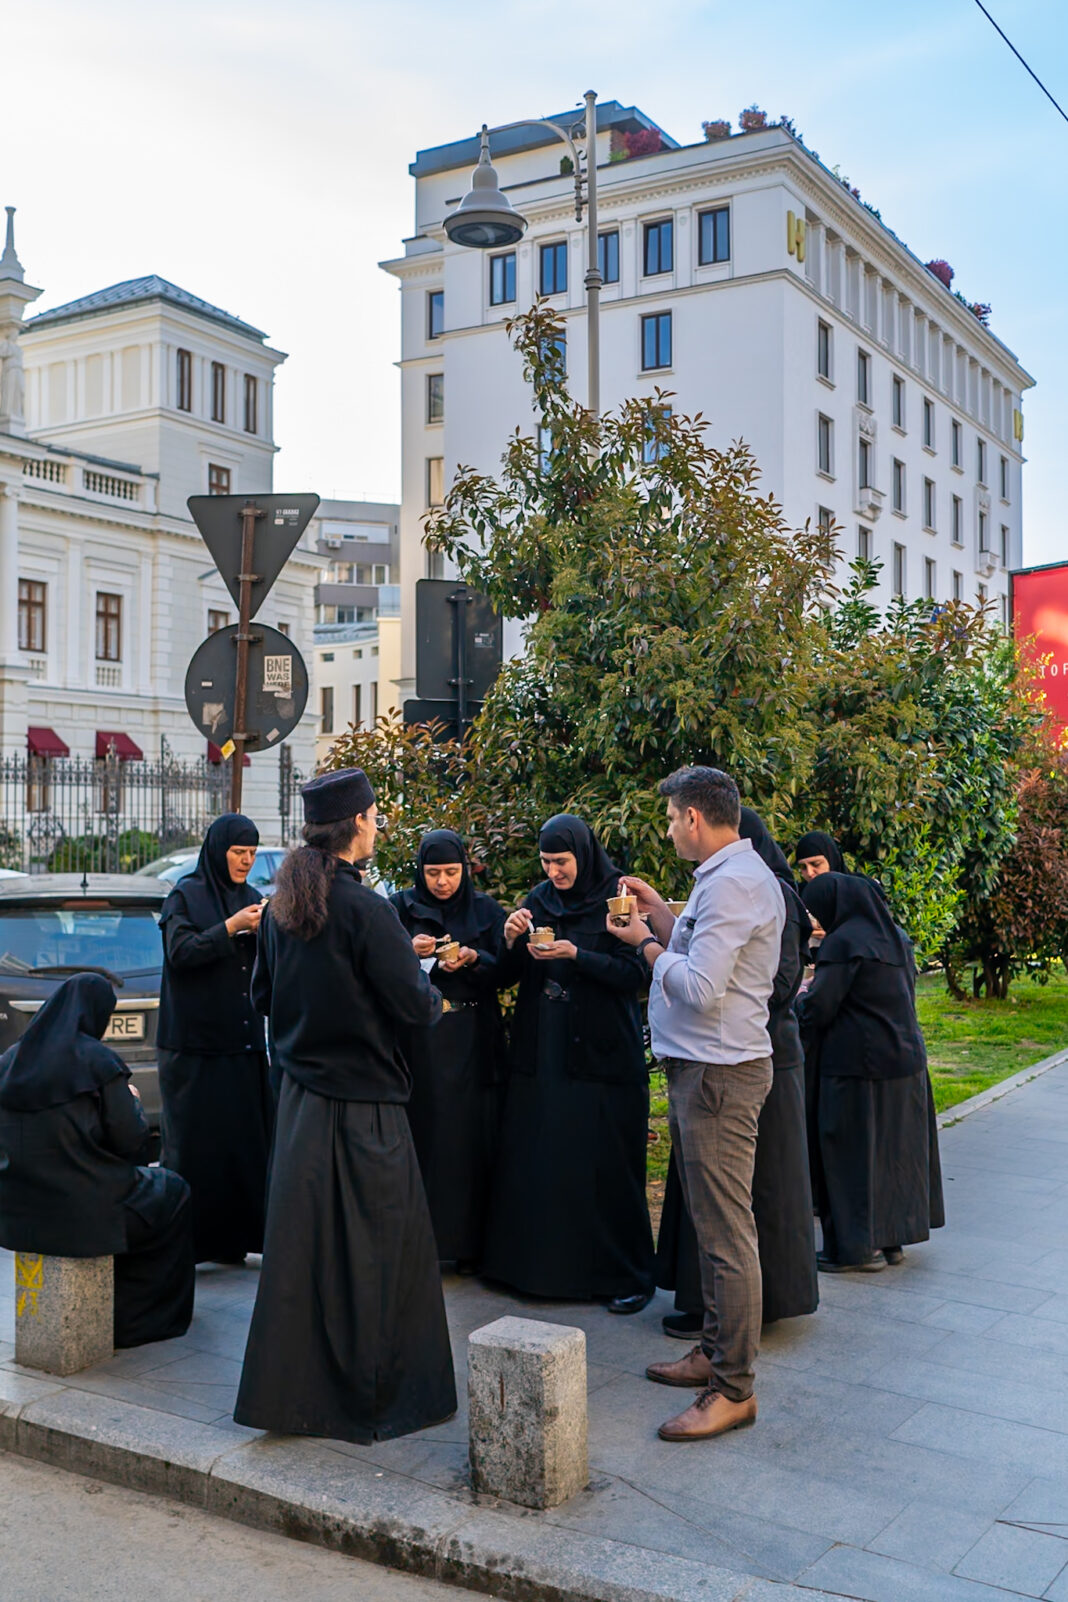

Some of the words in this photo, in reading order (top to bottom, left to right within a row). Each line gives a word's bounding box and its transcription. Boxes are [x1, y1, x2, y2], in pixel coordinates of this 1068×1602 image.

[266, 657, 290, 672] BNE
[266, 673, 290, 681] WAS
[108, 1016, 138, 1035] RE
